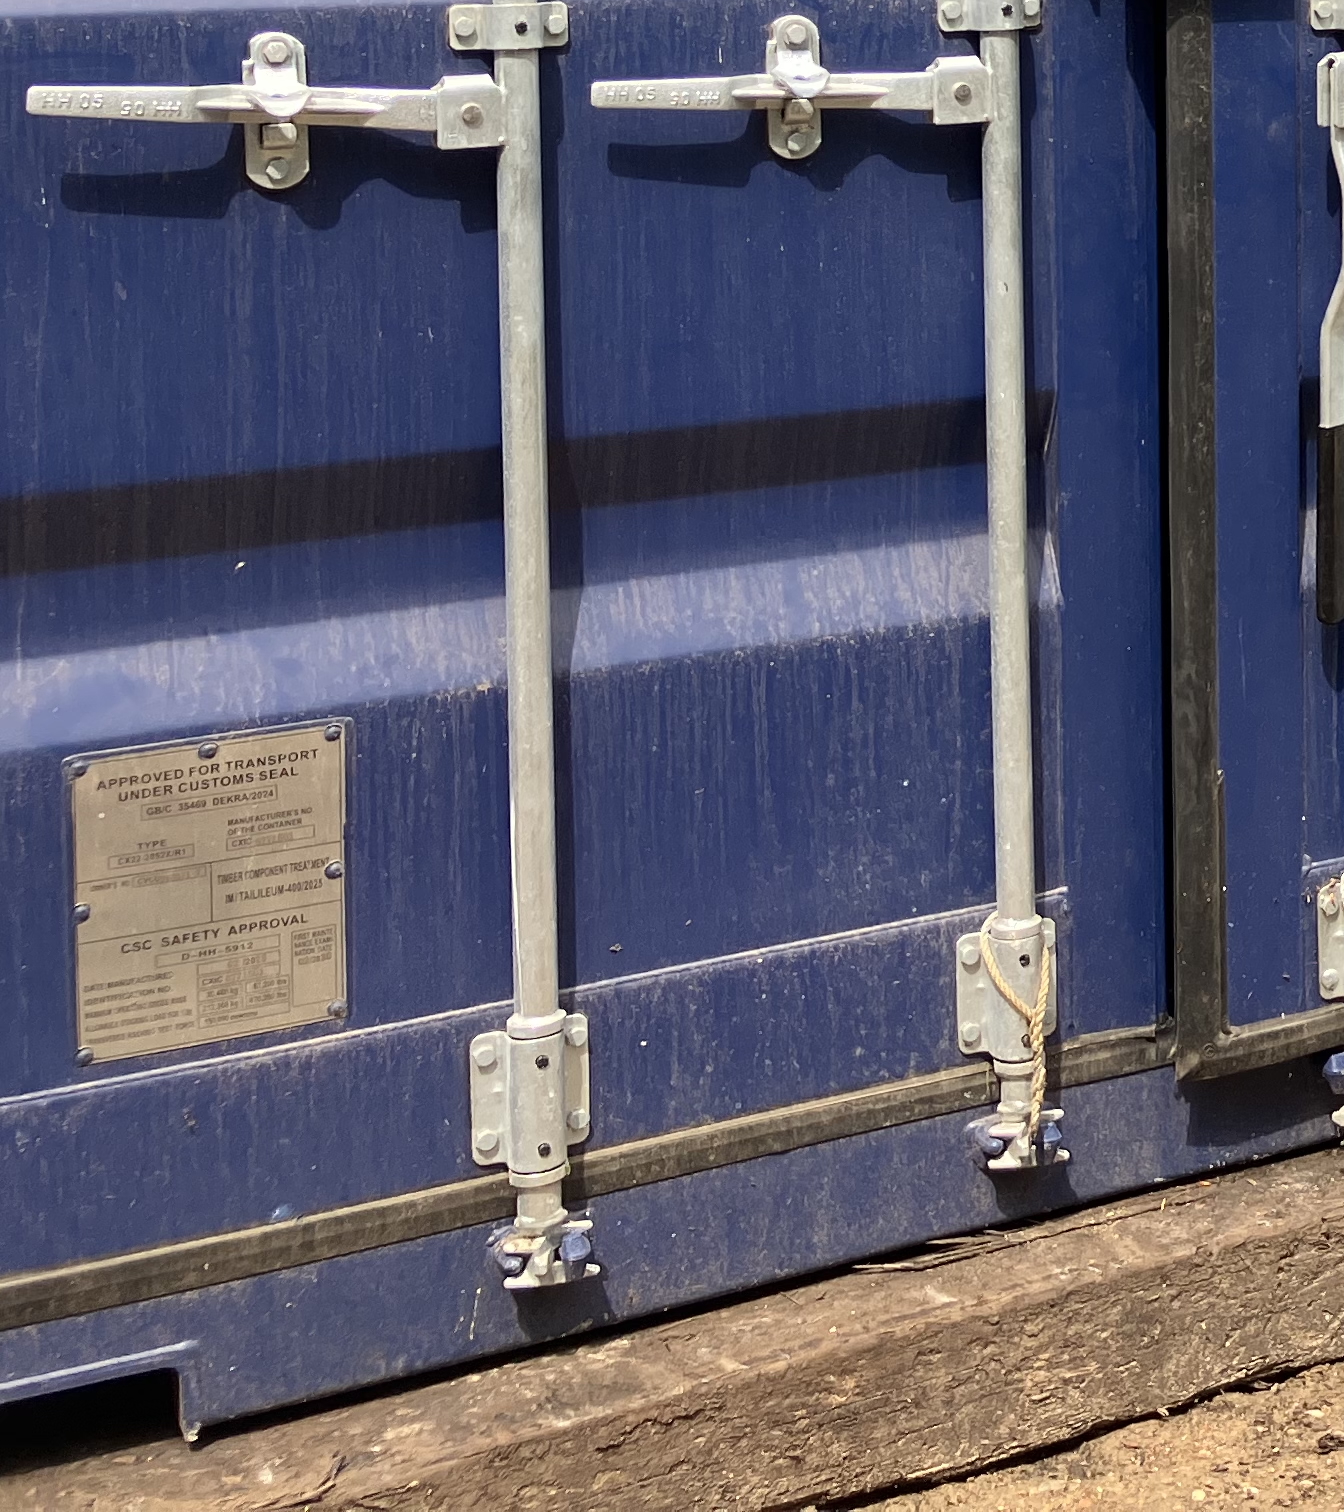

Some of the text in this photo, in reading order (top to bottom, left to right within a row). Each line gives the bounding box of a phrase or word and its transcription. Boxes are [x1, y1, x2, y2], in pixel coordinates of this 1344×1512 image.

[96, 748, 319, 792] APPROVED FOR TRANSPORT
[118, 766, 299, 802] UNDER CUSTOMS SEAL
[137, 838, 168, 850] TYPE
[120, 913, 309, 954] CSC SAFETY APPROVAL
